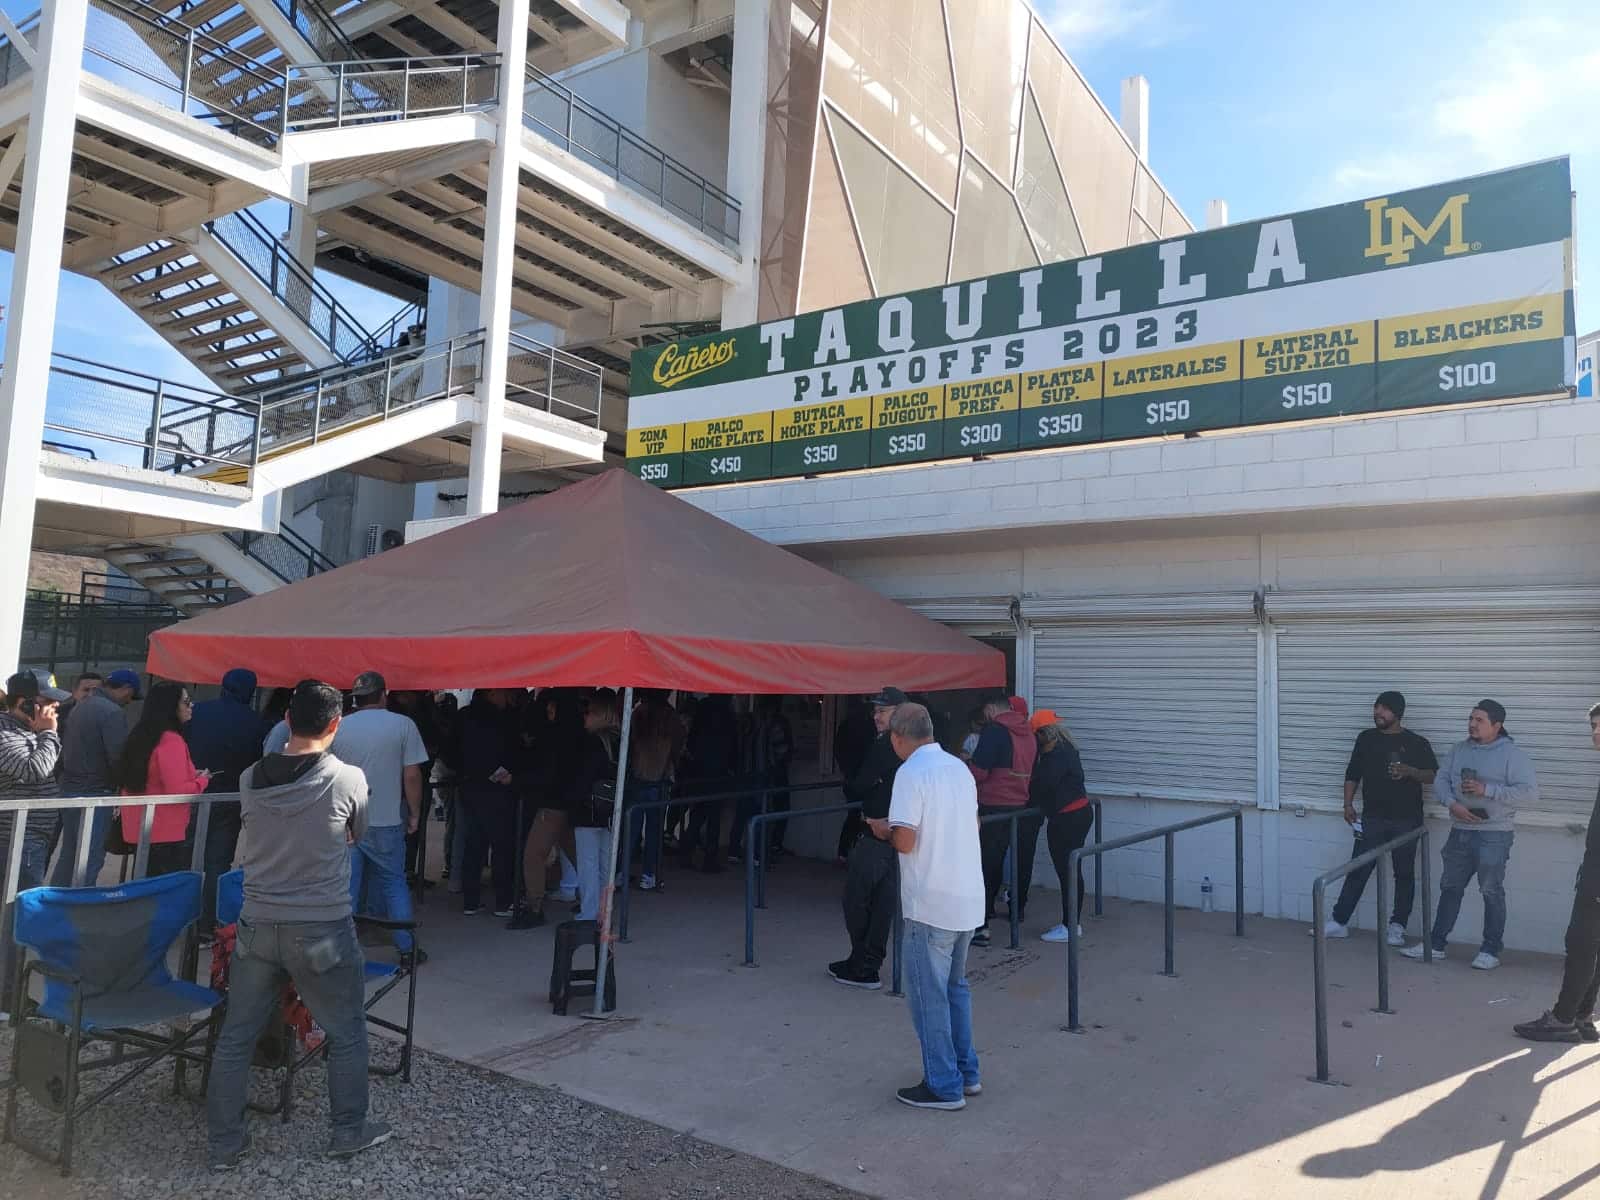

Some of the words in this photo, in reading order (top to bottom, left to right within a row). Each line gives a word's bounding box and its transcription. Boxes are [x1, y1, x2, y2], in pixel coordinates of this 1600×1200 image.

[760, 218, 1306, 373] TAQUILLA
[1394, 310, 1543, 349] BLEACHERS
[1257, 329, 1358, 357] LATERAL
[652, 337, 737, 388] Cañeros
[793, 339, 1025, 402] PLAYOFFS
[1063, 309, 1198, 361] 2023
[1027, 367, 1095, 391] PLATEA
[1113, 356, 1227, 387] LATERALES
[1438, 361, 1496, 391] $100
[884, 392, 929, 411] PALCO
[950, 380, 1013, 401] BUTACA
[1041, 386, 1080, 404] SUP.
[1282, 382, 1332, 409] $150
[793, 405, 845, 423] BUTACA
[879, 406, 938, 426] DUGOUT
[958, 399, 1004, 415] PREF.
[1146, 399, 1190, 425] $150
[640, 429, 668, 442] ZONA
[707, 419, 743, 435] PALCO
[780, 423, 816, 439] HOME
[820, 416, 864, 434] PLATE
[961, 423, 1001, 446] $300
[1038, 413, 1082, 438] $350
[646, 442, 665, 454] VIP
[691, 436, 722, 450] HOME
[726, 430, 764, 446] PLATE
[889, 433, 926, 455] $350
[710, 456, 742, 475] $450
[804, 444, 837, 465] $350
[640, 463, 669, 480] $550
